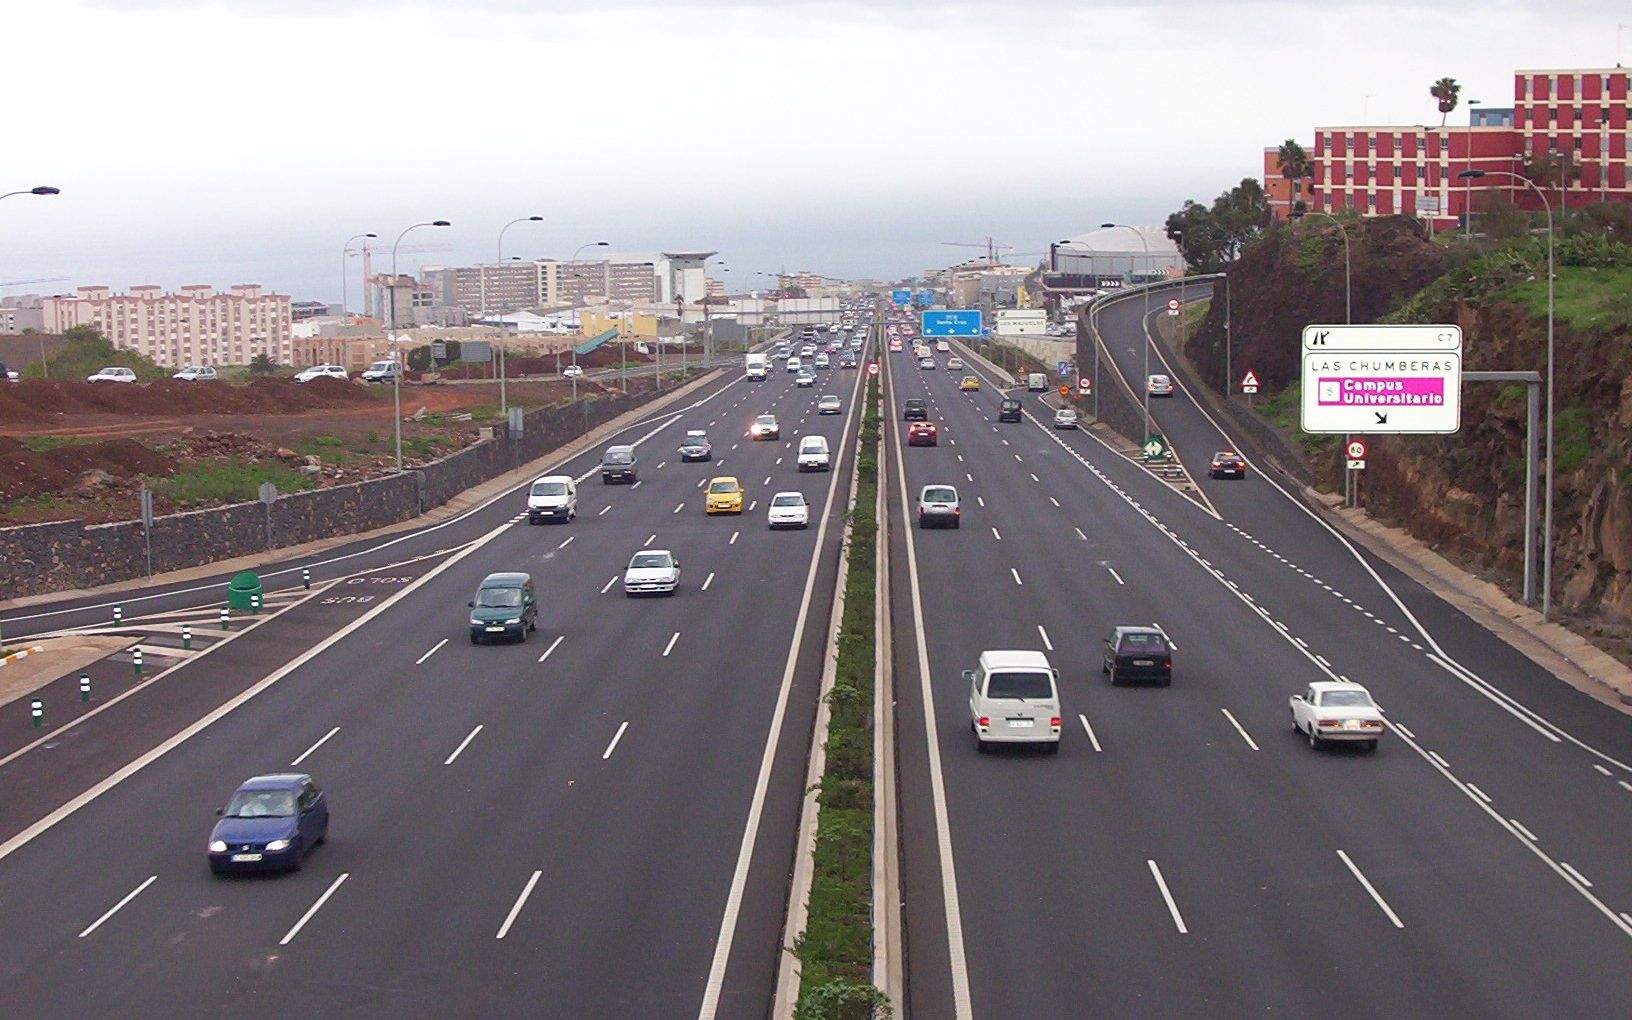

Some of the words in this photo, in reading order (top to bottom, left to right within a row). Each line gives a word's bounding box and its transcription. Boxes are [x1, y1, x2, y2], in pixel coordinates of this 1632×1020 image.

[1311, 361, 1341, 371] LAS
[1349, 361, 1452, 371] CHUMBERAS
[1343, 379, 1404, 393] Campus
[1343, 392, 1443, 404] Universitario
